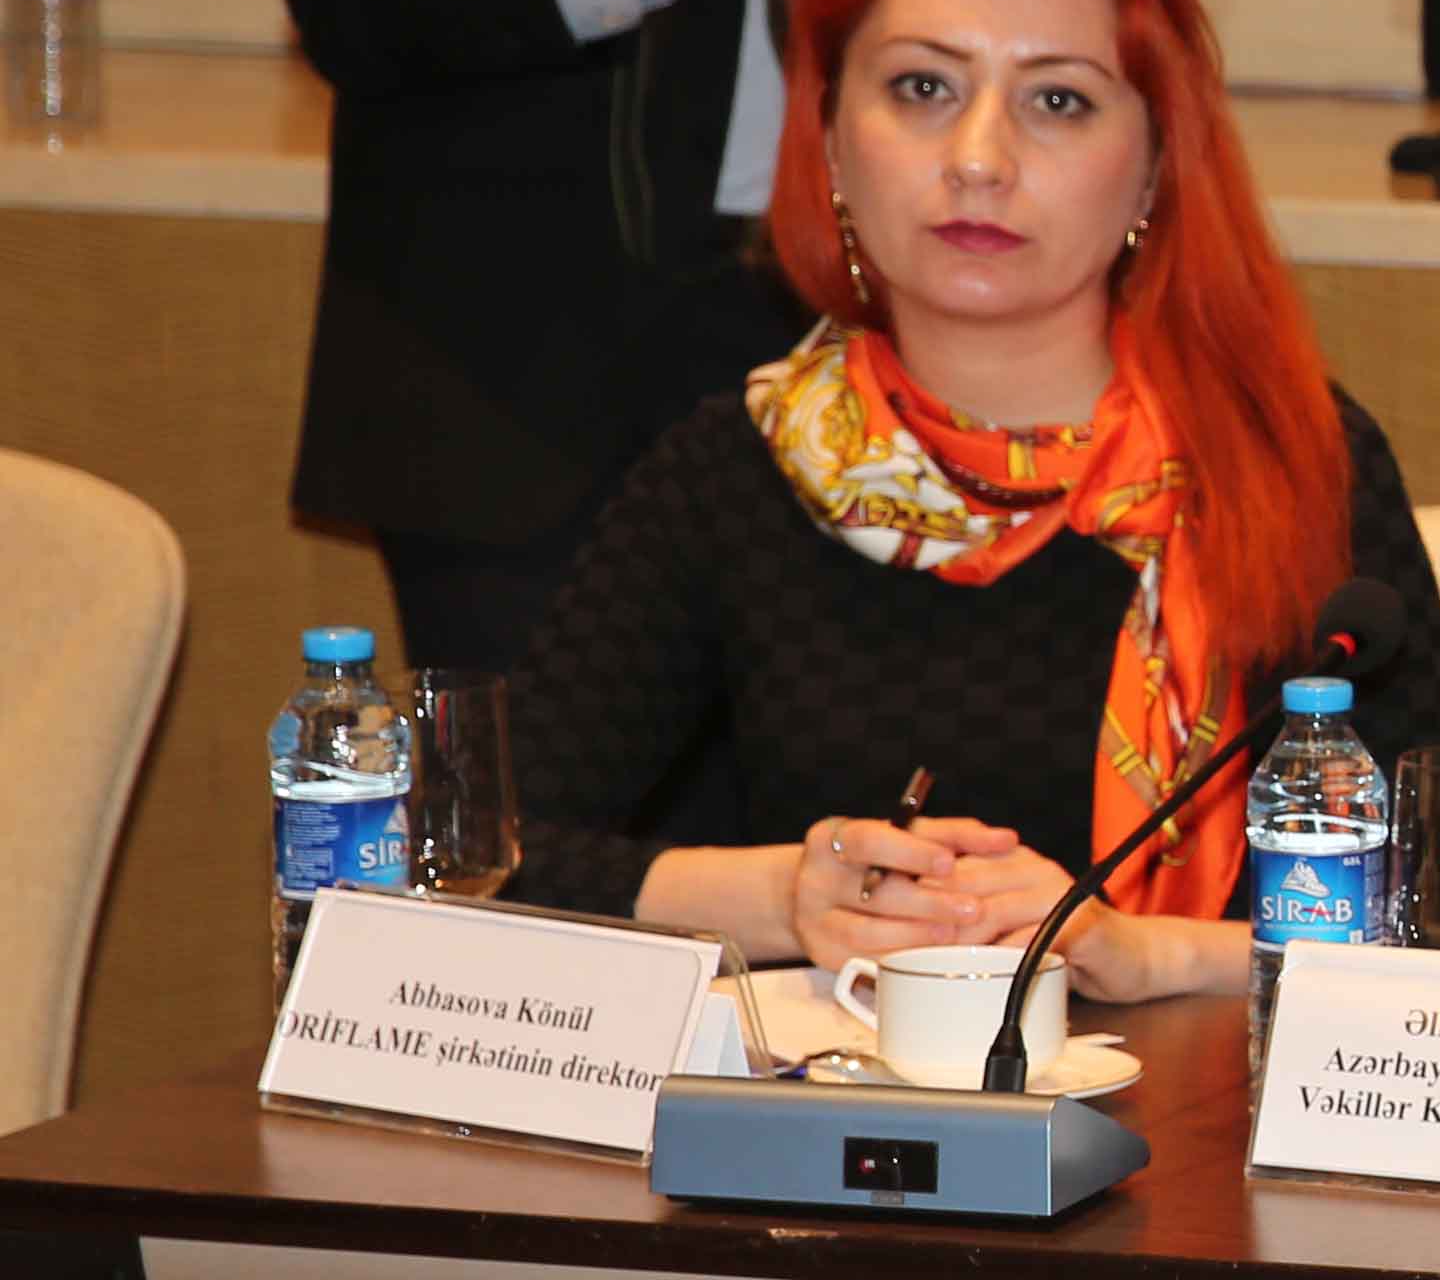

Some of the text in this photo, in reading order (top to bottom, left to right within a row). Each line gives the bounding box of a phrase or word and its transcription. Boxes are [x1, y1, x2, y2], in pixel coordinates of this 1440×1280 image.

[390, 981, 595, 1033] Abbasova Könül
[436, 1036, 553, 1076] şirkətinin
[1299, 1086, 1413, 1121] Vəkillər
